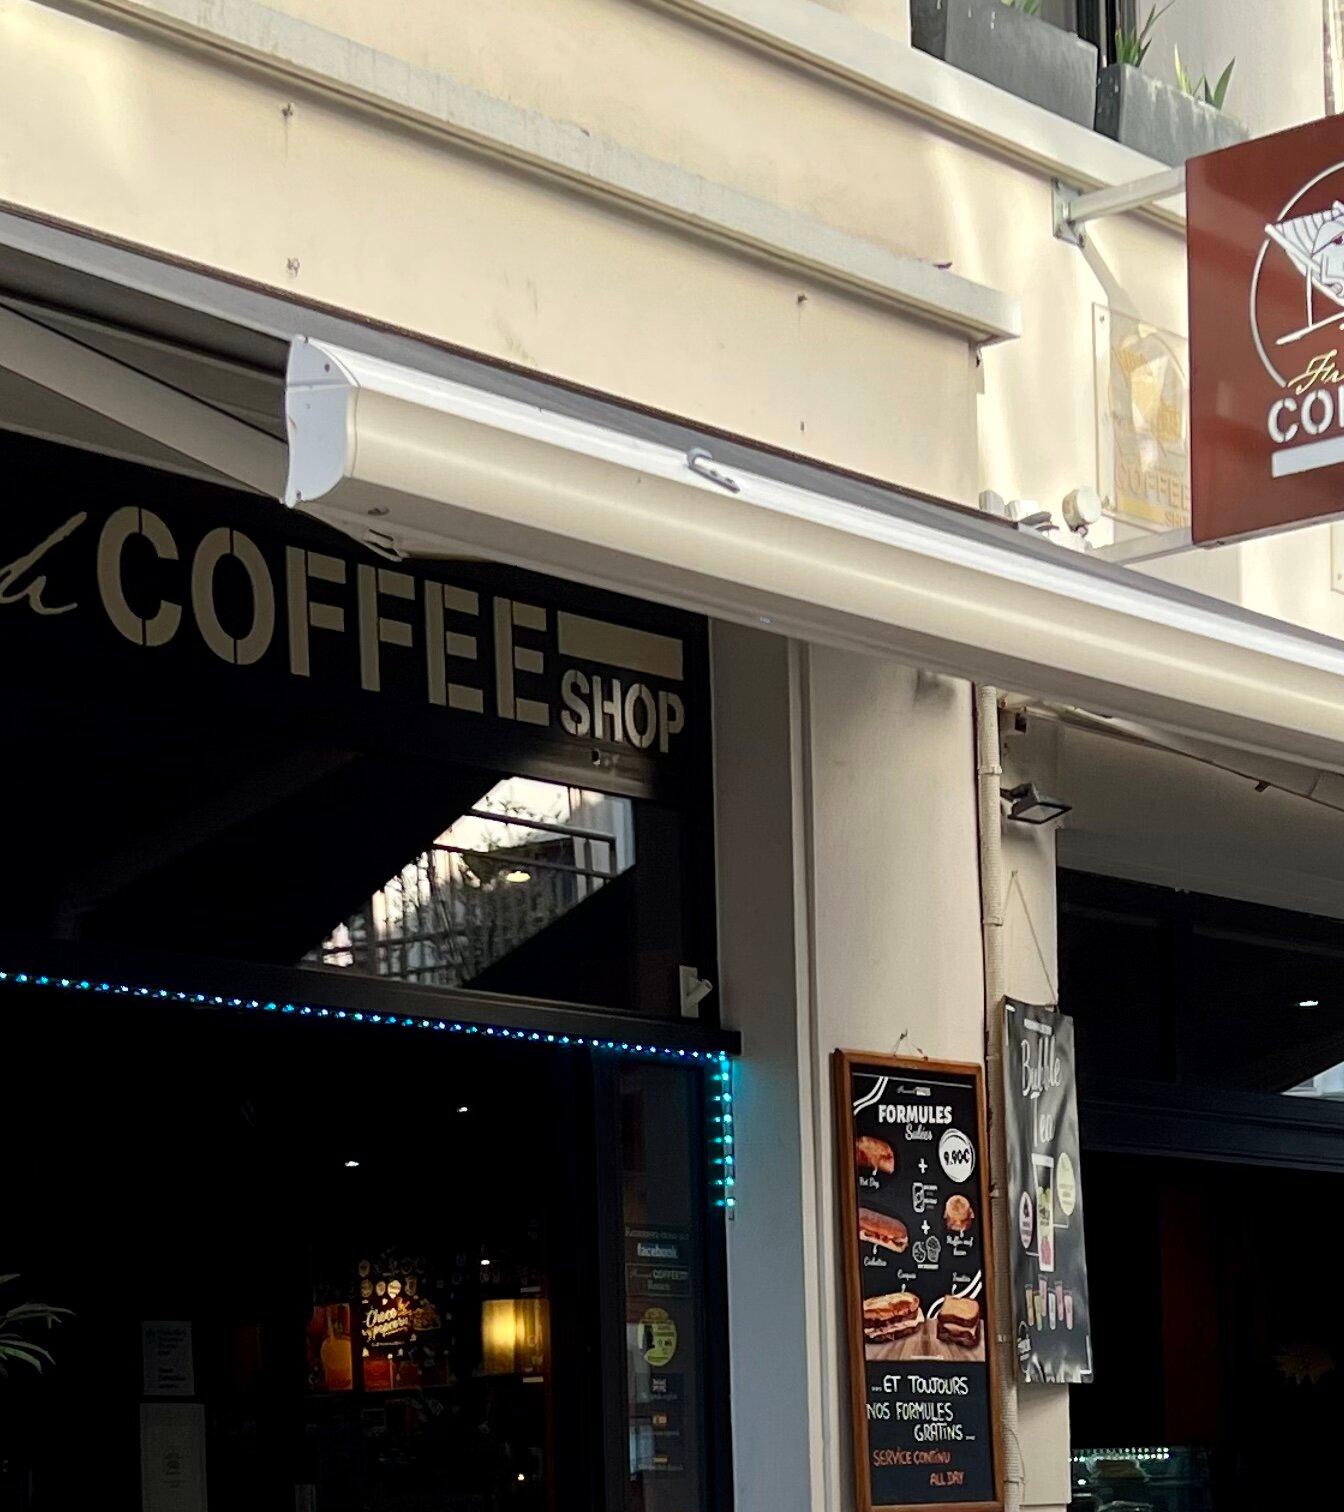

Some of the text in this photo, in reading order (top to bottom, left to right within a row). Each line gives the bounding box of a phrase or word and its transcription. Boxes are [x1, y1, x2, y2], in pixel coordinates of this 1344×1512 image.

[97, 505, 550, 727] COFFEE
[559, 667, 685, 754] SHOP
[1021, 1034, 1061, 1097] Bubble
[878, 1104, 953, 1124] FORMULES
[907, 1375, 969, 1395] TOUJOURS
[866, 1402, 954, 1422] NOS FORMULES
